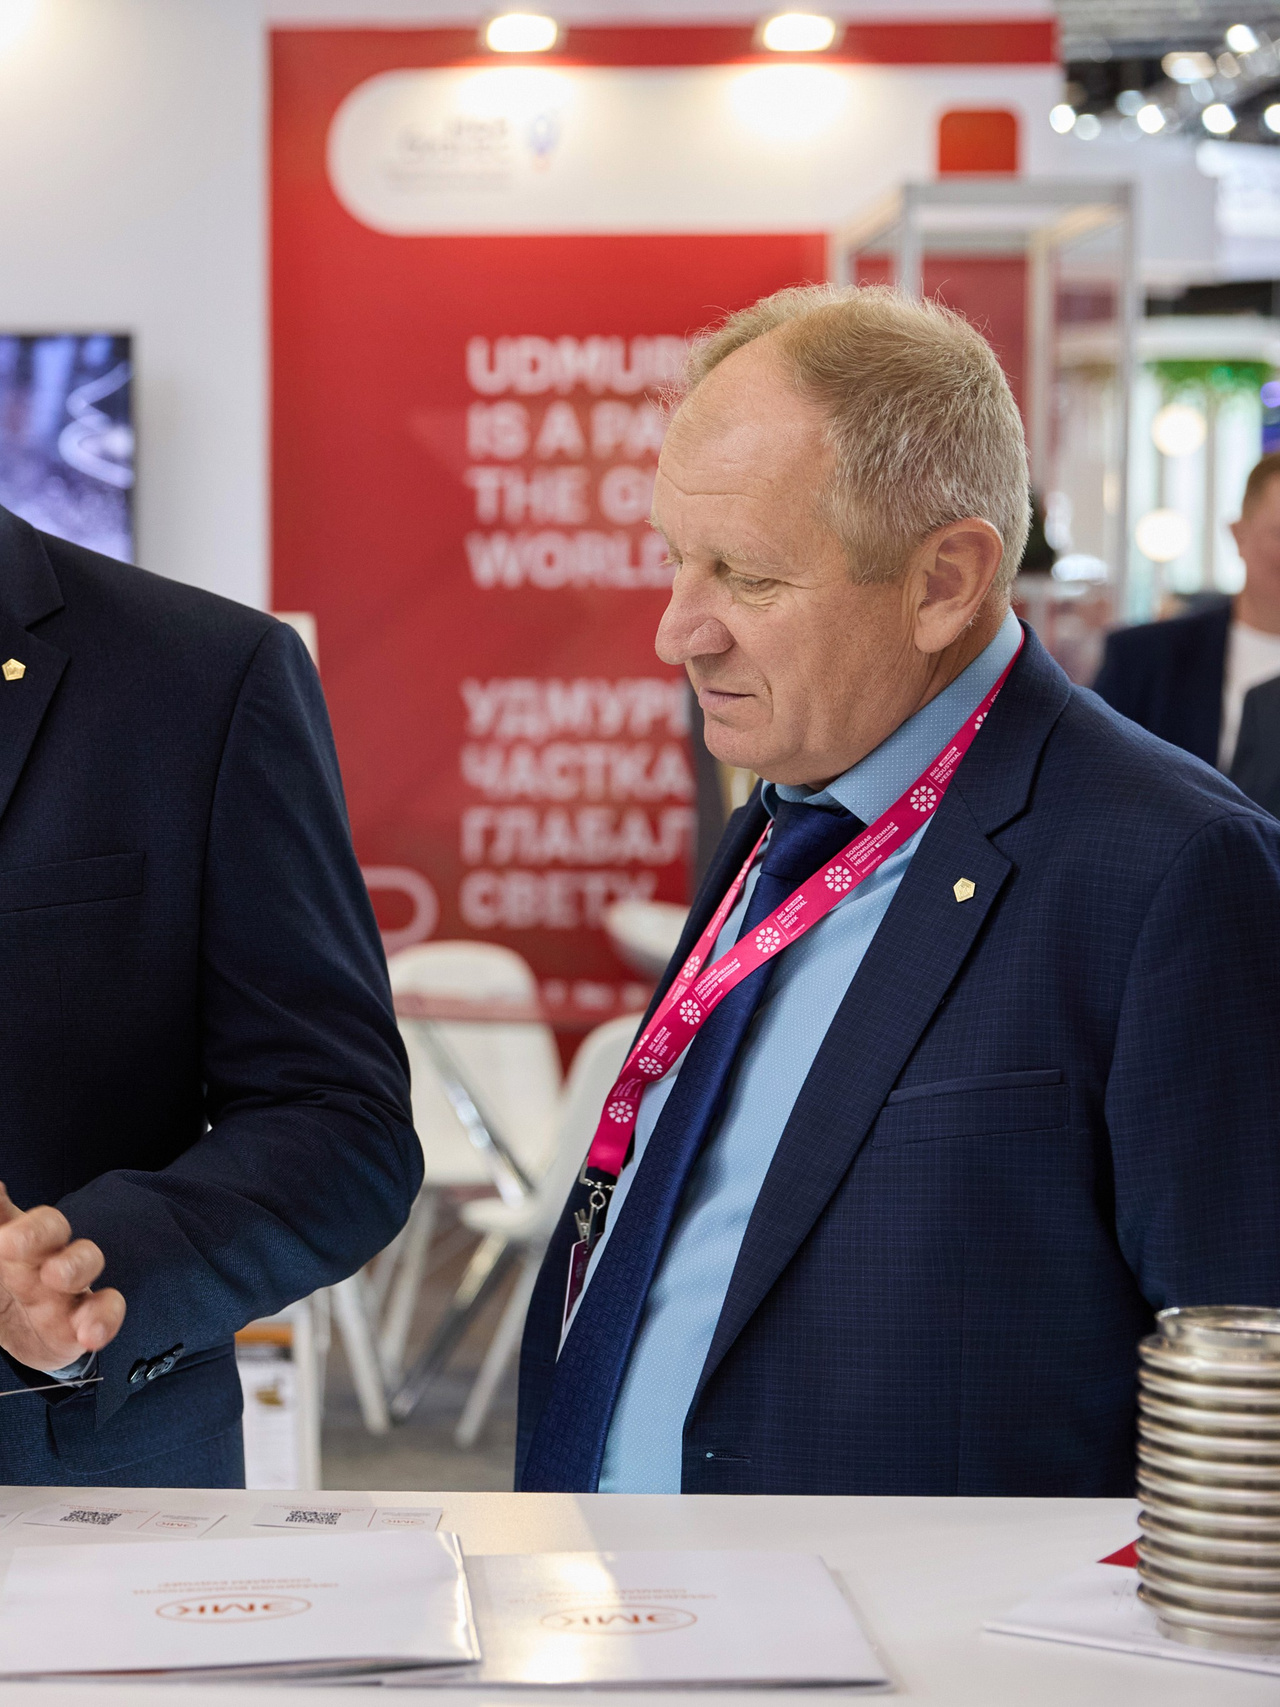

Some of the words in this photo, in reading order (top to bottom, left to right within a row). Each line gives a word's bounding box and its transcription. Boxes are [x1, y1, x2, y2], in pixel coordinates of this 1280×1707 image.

[466, 334, 690, 396] UDMUR
[466, 399, 531, 461] IS
[533, 399, 587, 460] A
[589, 399, 665, 460] PA
[463, 465, 591, 526] THE
[461, 676, 692, 743] УДМУР
[461, 742, 696, 800] ЧАСТКА
[929, 766, 940, 777] BIG
[933, 750, 962, 781] INDUSTRIAL
[937, 768, 954, 784] WEEK
[462, 805, 696, 867] ГЛАБАЛ
[845, 834, 872, 858] БОЛЬШАЯ
[849, 821, 895, 862] ПРОМЫШЛЕННАЯ
[853, 847, 876, 867] НЕДЕЛЯ
[776, 910, 786, 921] BIG
[780, 899, 808, 925] INDUSTRIAL
[784, 914, 800, 929] WEEK
[694, 968, 718, 992] БОЛЬШАЯ
[697, 957, 739, 997] ПРОМЫШЛЕННАЯ
[701, 981, 719, 1001] НЕДЕЛЯ
